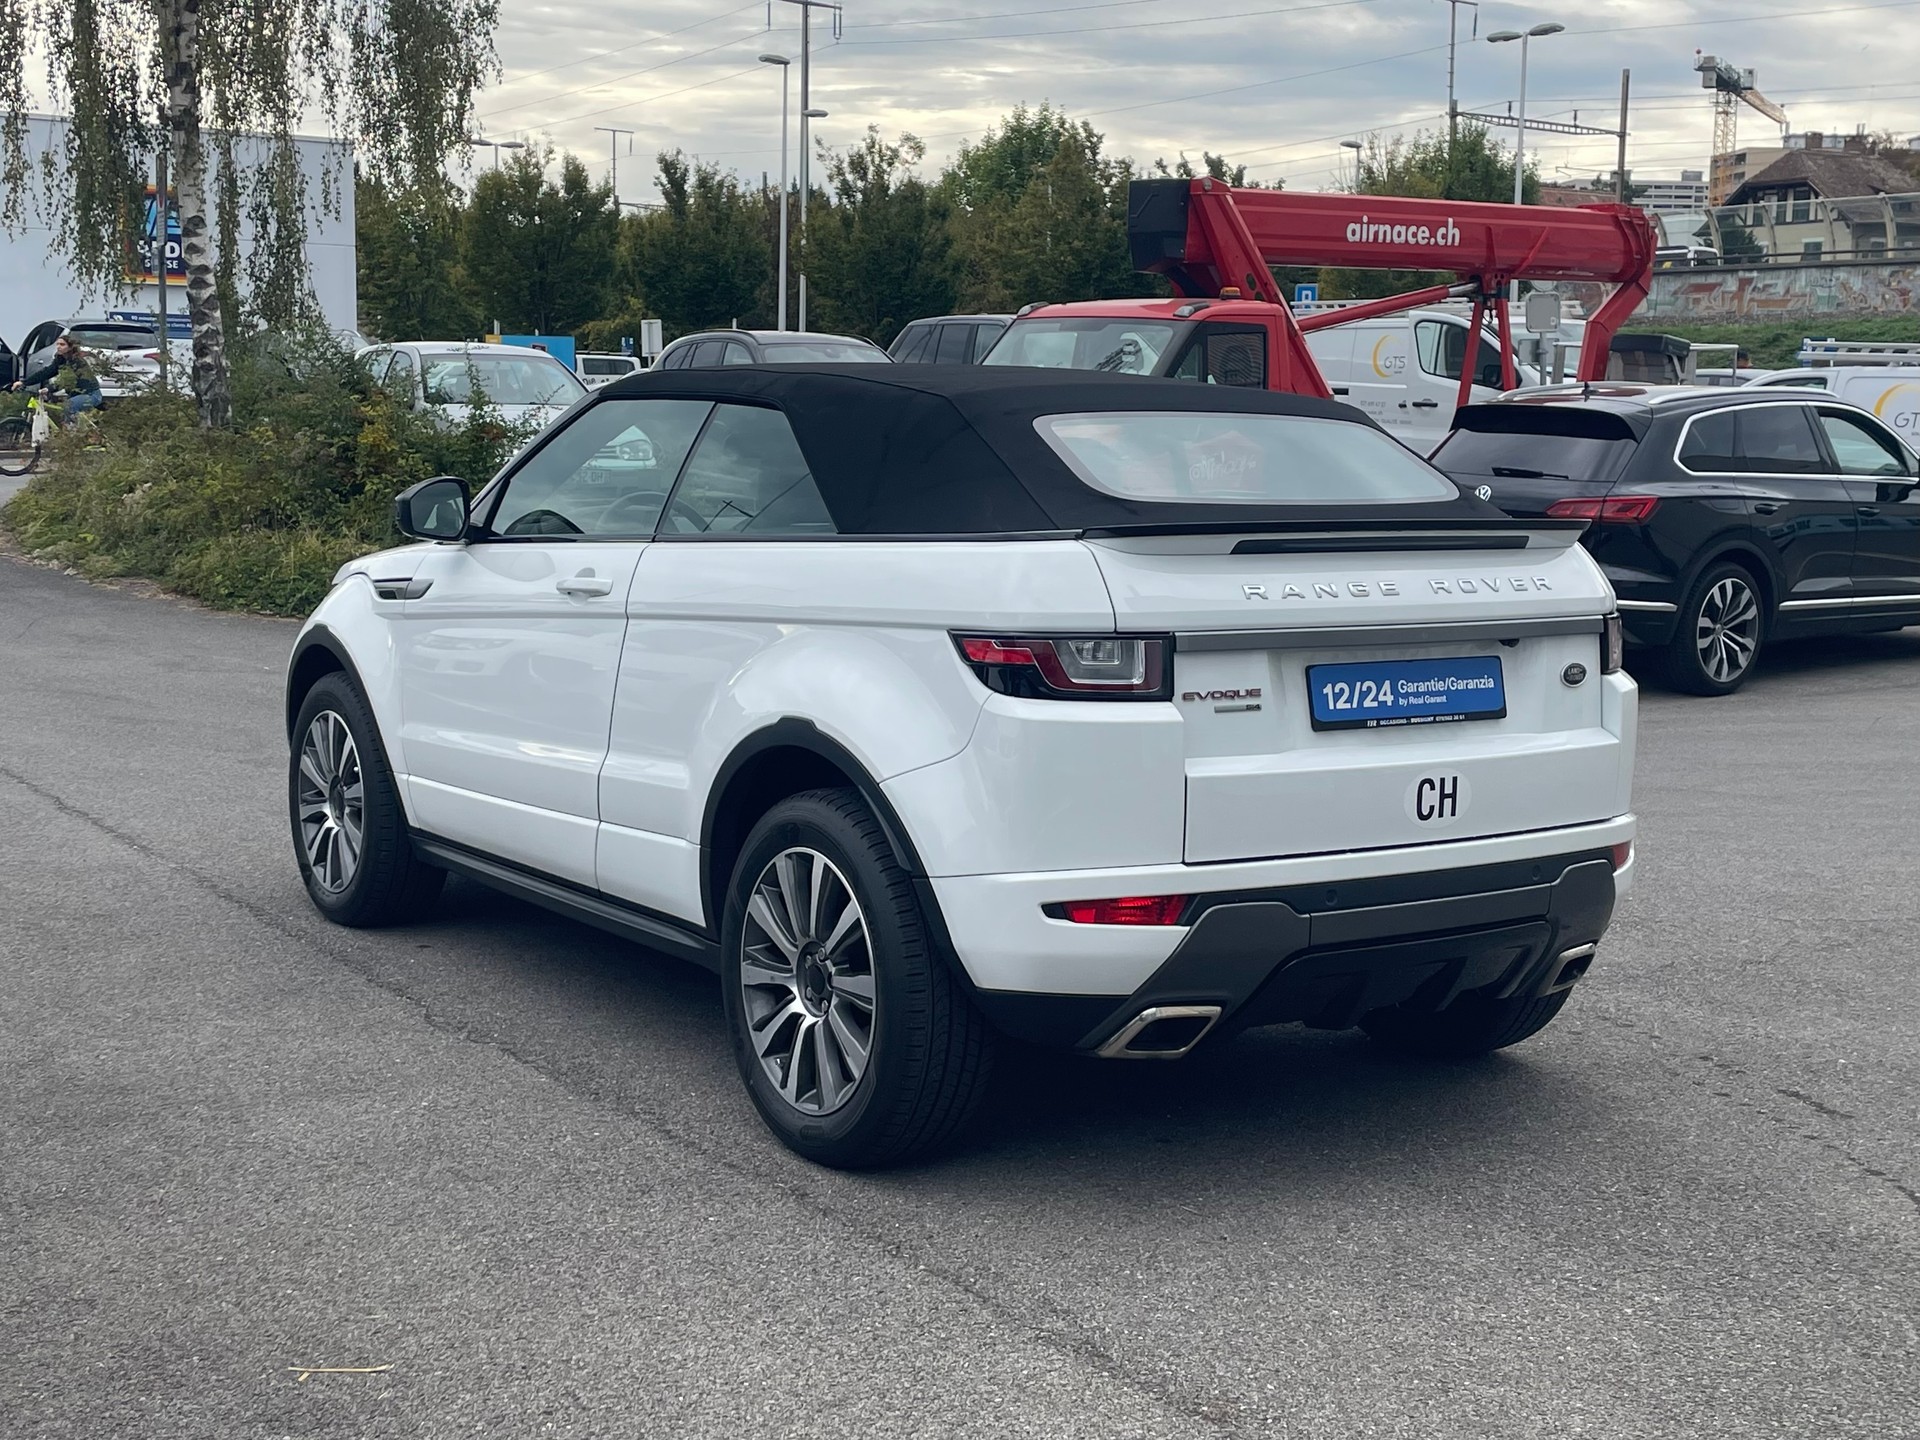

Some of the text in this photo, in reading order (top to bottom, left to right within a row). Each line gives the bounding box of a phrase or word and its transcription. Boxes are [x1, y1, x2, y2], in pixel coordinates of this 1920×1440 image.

[1346, 215, 1460, 246] airnace.ch
[1384, 356, 1405, 369] GTS
[1241, 576, 1552, 600] RANGE ROVER
[1182, 688, 1261, 701] EVOQUE
[1323, 675, 1494, 711] 12/24 Garantie/Garanzia
[1399, 694, 1447, 707] by Real Garant
[1416, 776, 1458, 821] CH
